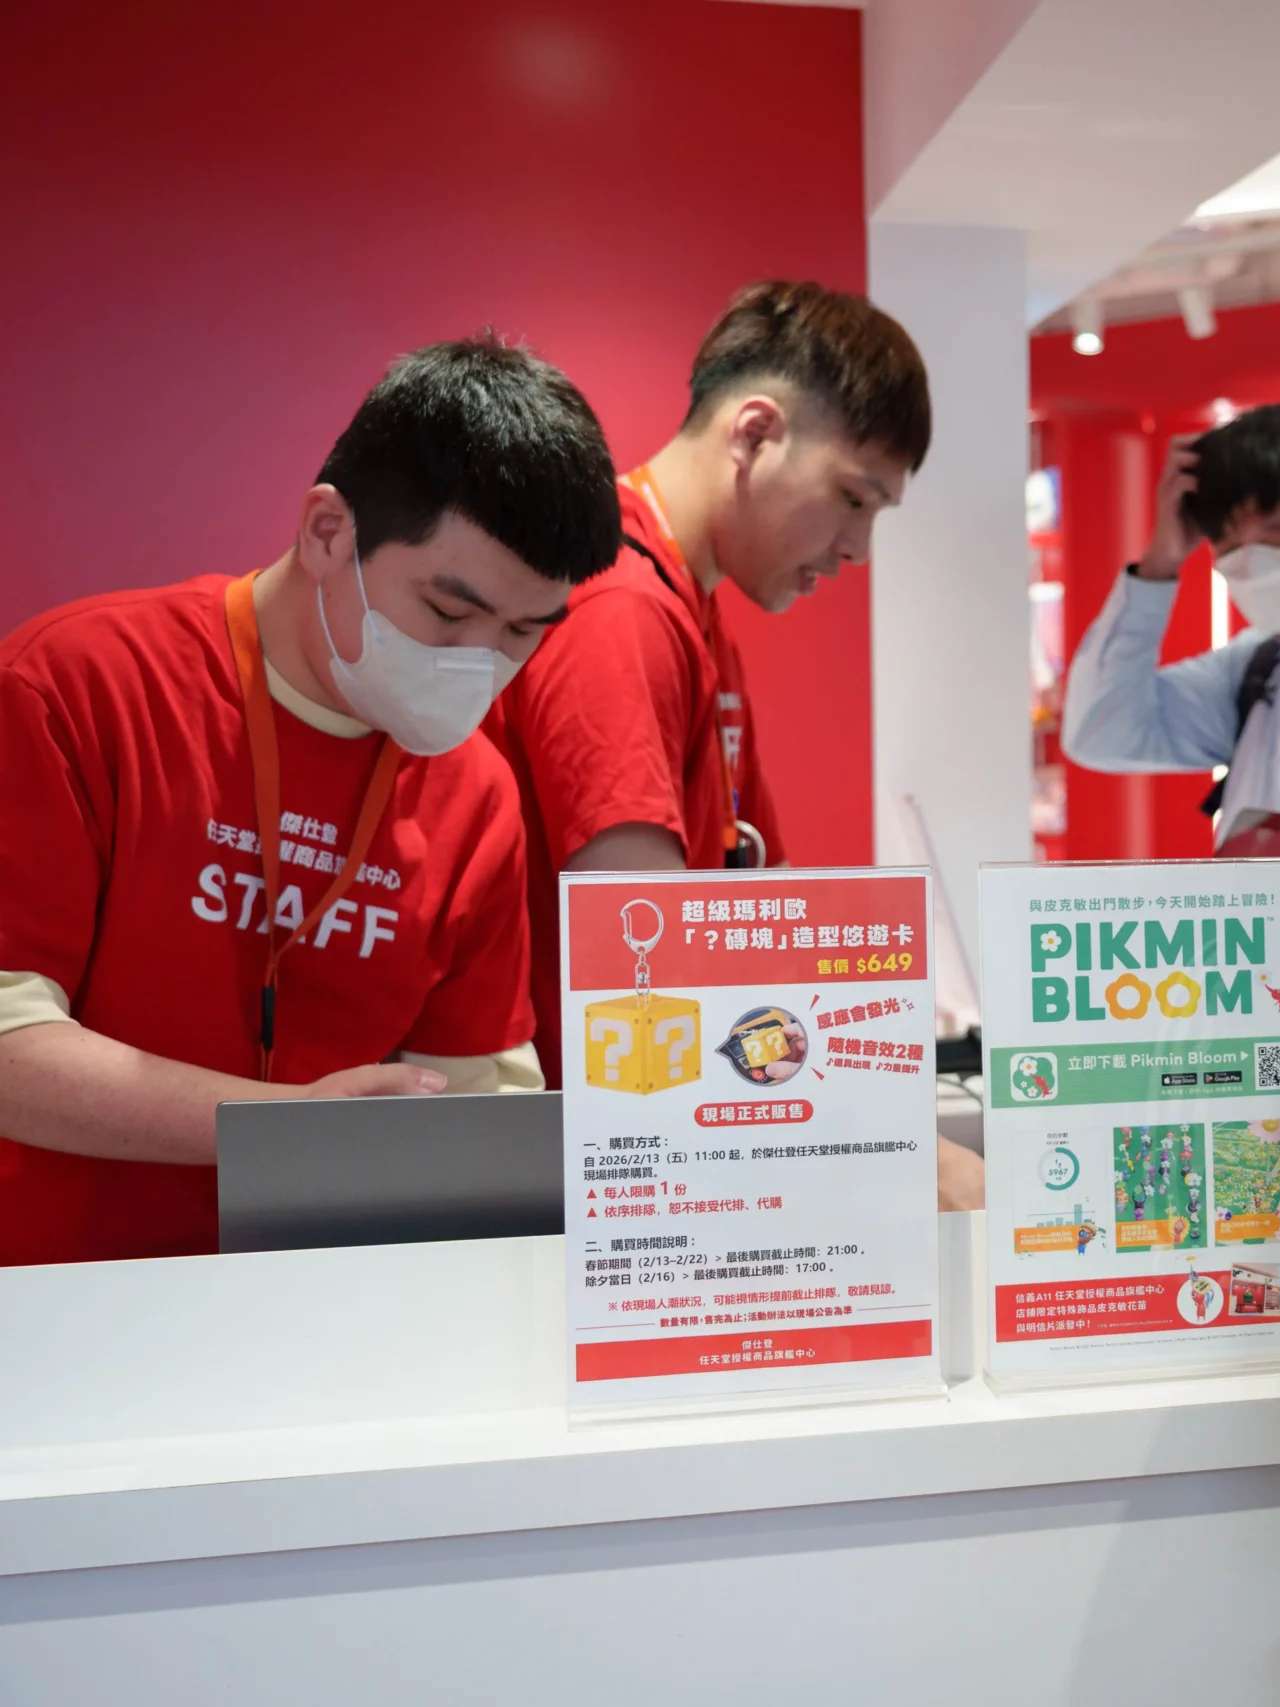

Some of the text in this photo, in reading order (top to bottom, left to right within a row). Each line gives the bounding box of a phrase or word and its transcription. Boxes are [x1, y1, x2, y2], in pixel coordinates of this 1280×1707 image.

[280, 811, 337, 846] 傑仕登
[191, 863, 399, 958] STAFF
[682, 898, 807, 923] 超級瑪利歐
[1030, 917, 1265, 973] PIKMIN
[817, 952, 912, 975] 售價 $649
[1032, 969, 1253, 1023] BLOOM
[817, 998, 900, 1030] 感應會發光
[827, 1036, 924, 1061] 隨機音效2種
[1068, 1051, 1237, 1071] 立即下載 Pikmin Bloom
[702, 1103, 804, 1123] 現場正式販售
[584, 1167, 658, 1181] 現場排隊購買。
[604, 1185, 655, 1200] 每人限購
[1015, 1293, 1052, 1304] 信義A11
[741, 1338, 773, 1350] 傑仕登
